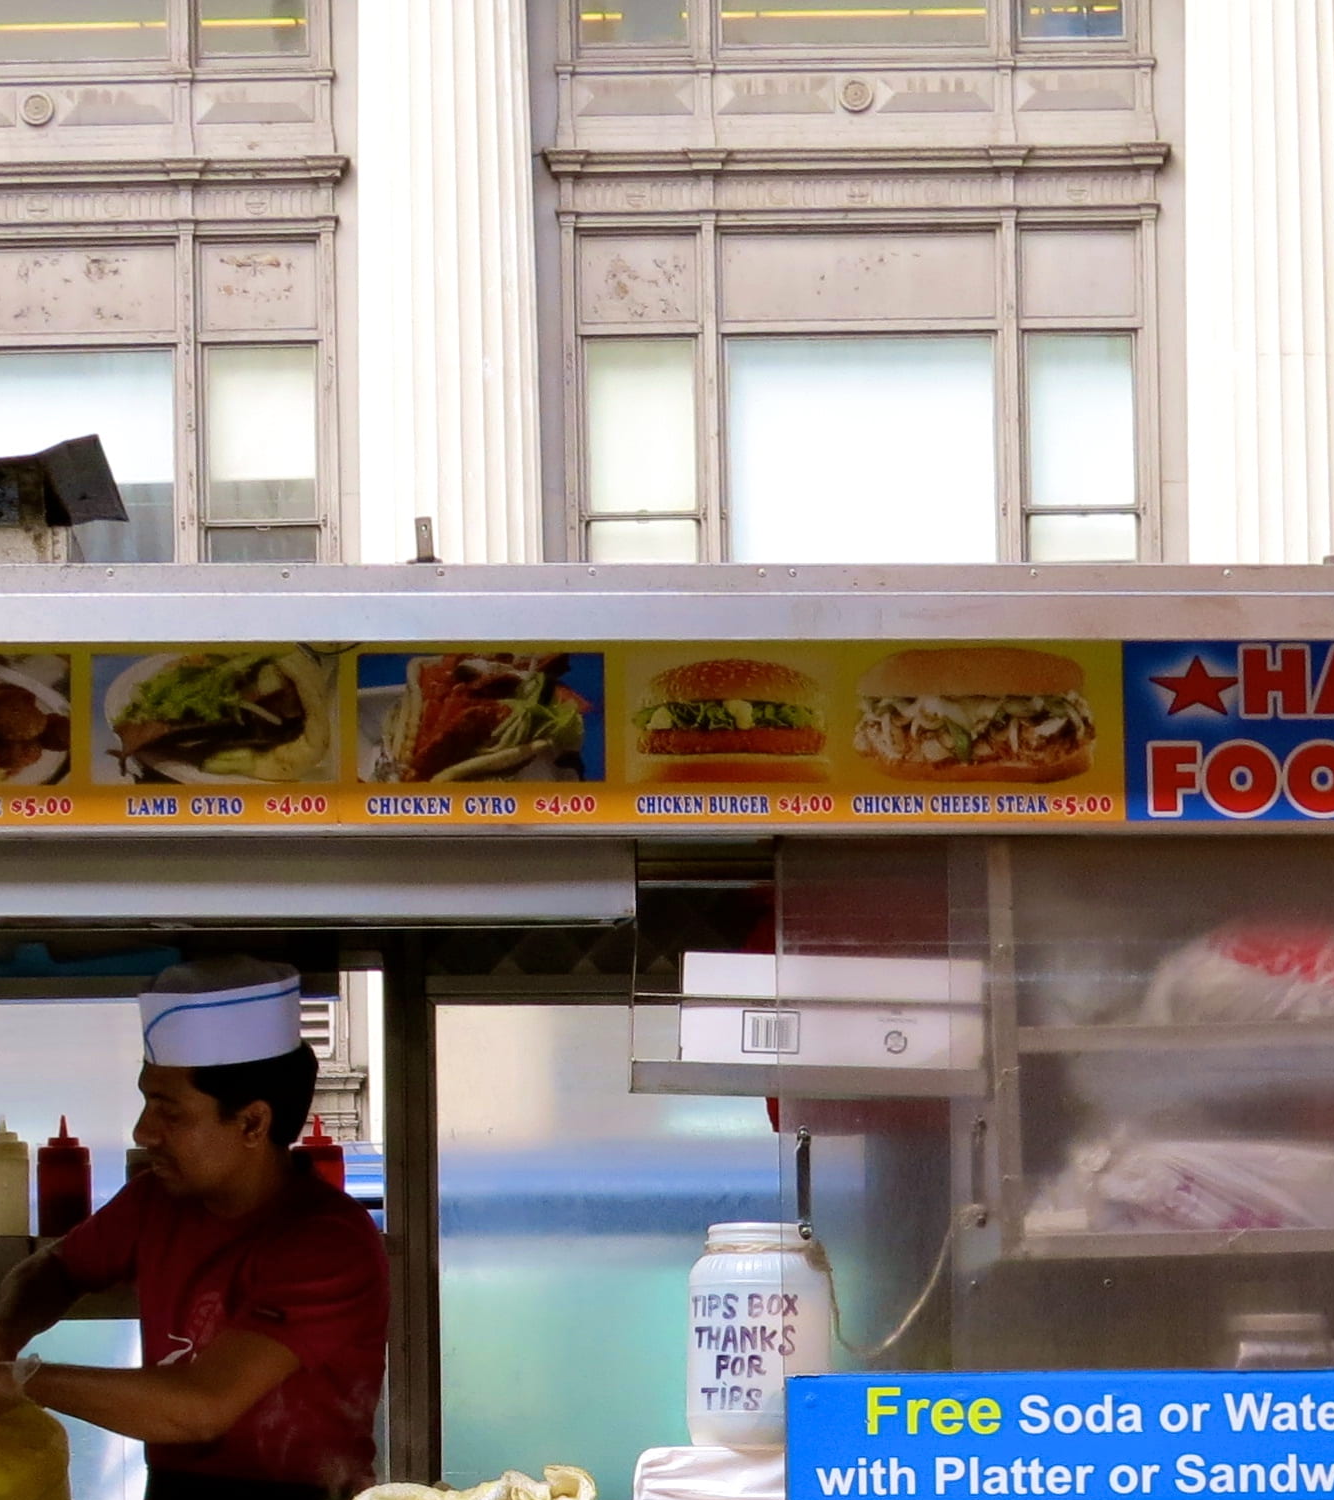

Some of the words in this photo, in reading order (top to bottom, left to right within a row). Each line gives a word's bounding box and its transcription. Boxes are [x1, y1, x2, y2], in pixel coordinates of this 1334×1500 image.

[10, 798, 73, 815] $5.00
[127, 798, 178, 816] LAMB
[191, 797, 243, 816] GYRO
[267, 796, 328, 815] $4.00
[367, 797, 451, 816] CHICKEN
[465, 797, 516, 815] GYRO
[535, 796, 596, 814] $4.00
[637, 796, 704, 815] CHICKEN
[710, 796, 769, 815] BURGER
[778, 795, 834, 814] $4.00
[853, 796, 923, 814] CHICKEN
[931, 796, 990, 814] CHEESE
[997, 796, 1048, 814] STEAK
[1052, 796, 1112, 814] $5.00
[692, 1294, 738, 1319] TIPS
[748, 1294, 798, 1318] BOX
[696, 1326, 796, 1355] THANKS
[716, 1355, 766, 1379] FOR
[867, 1387, 1002, 1435] Free
[1019, 1394, 1143, 1434] Soda
[1159, 1399, 1211, 1433] or
[816, 1457, 915, 1496] with
[934, 1456, 1094, 1495] Platter
[1109, 1461, 1160, 1492] or
